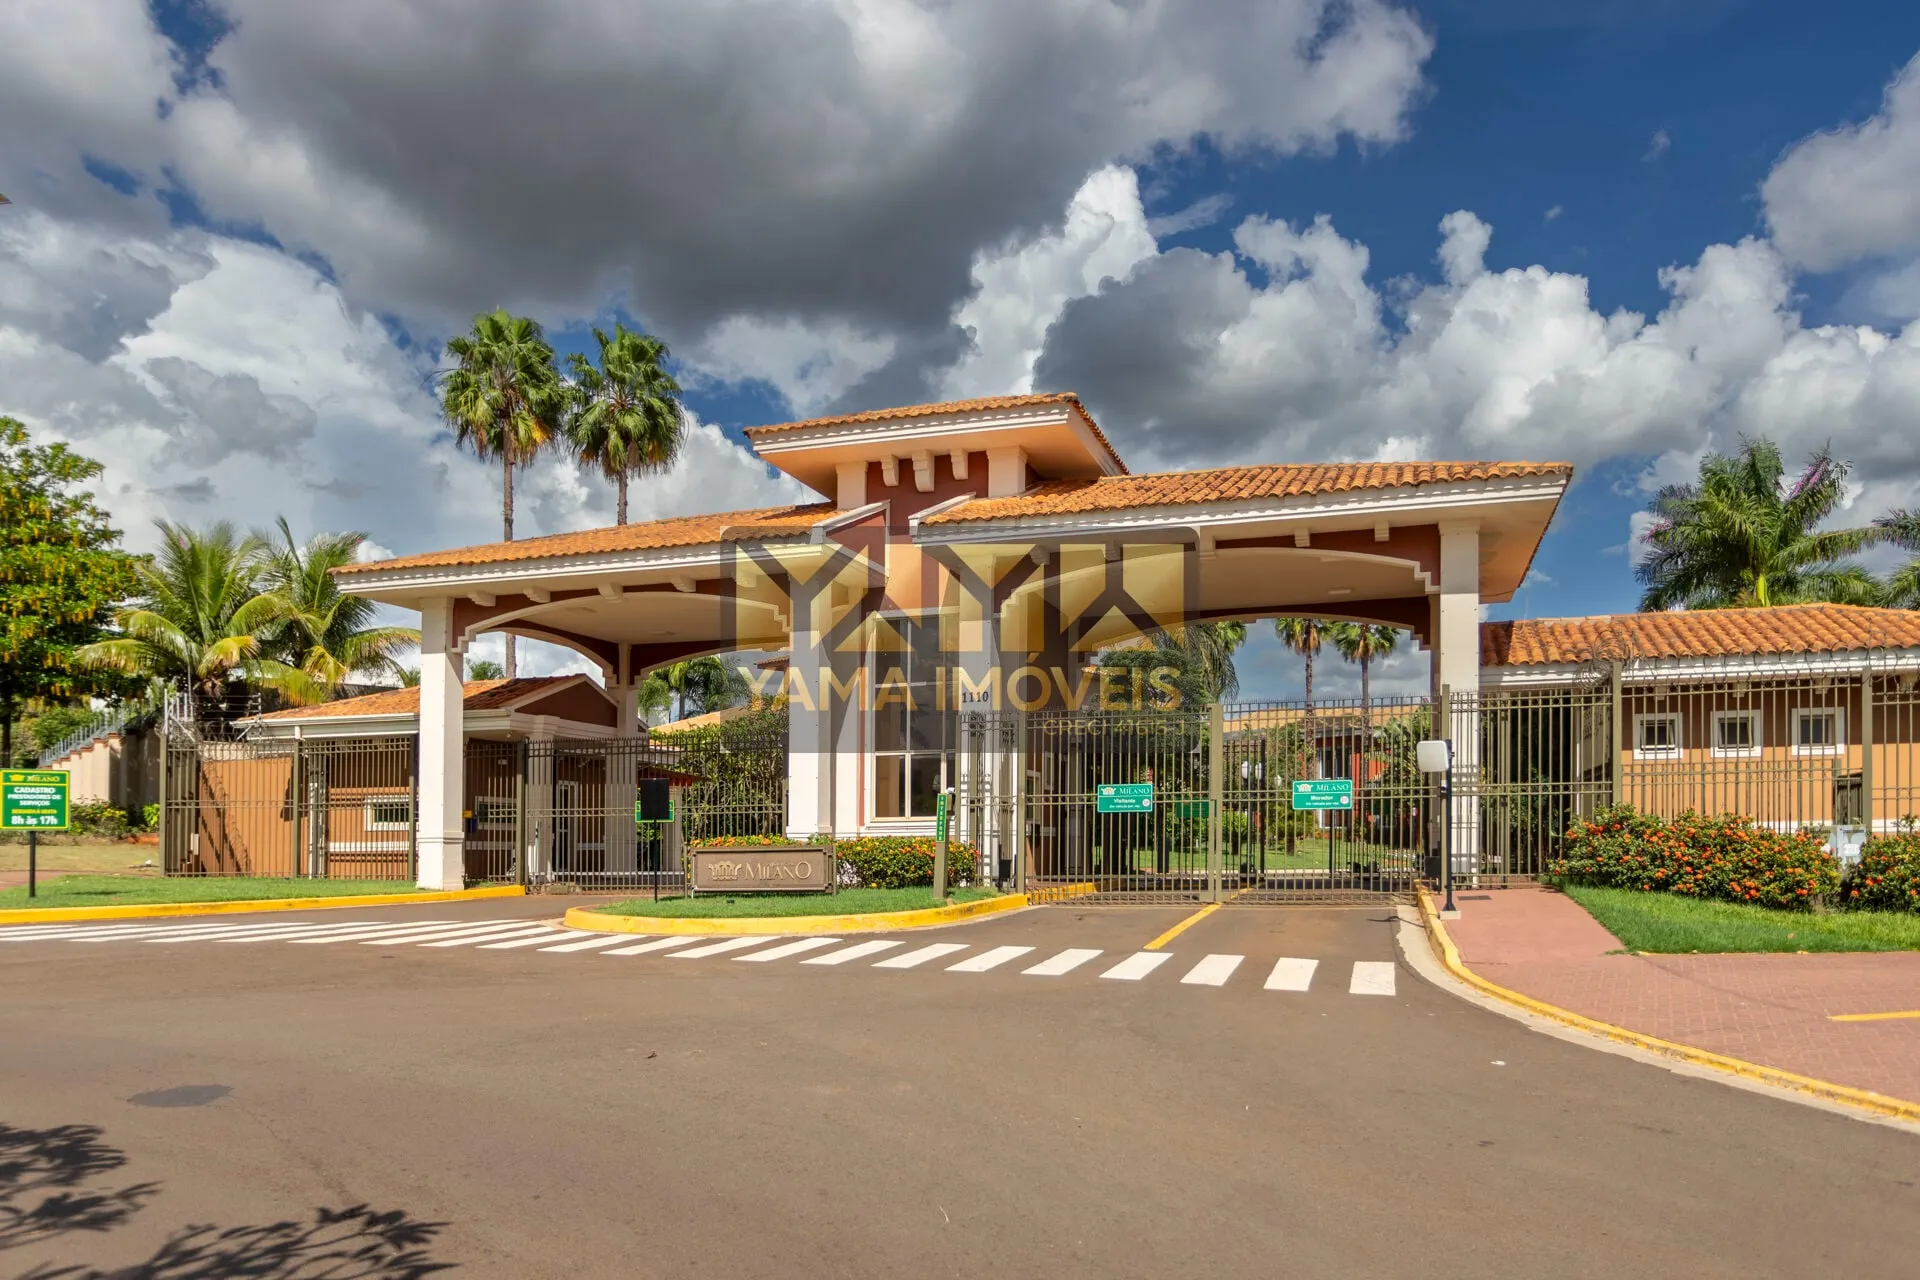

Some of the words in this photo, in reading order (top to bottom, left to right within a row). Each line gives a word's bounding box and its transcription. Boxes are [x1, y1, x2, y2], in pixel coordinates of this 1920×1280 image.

[962, 691, 989, 703] 1110
[14, 786, 56, 794] CADASTRO
[40, 815, 58, 825] 17h
